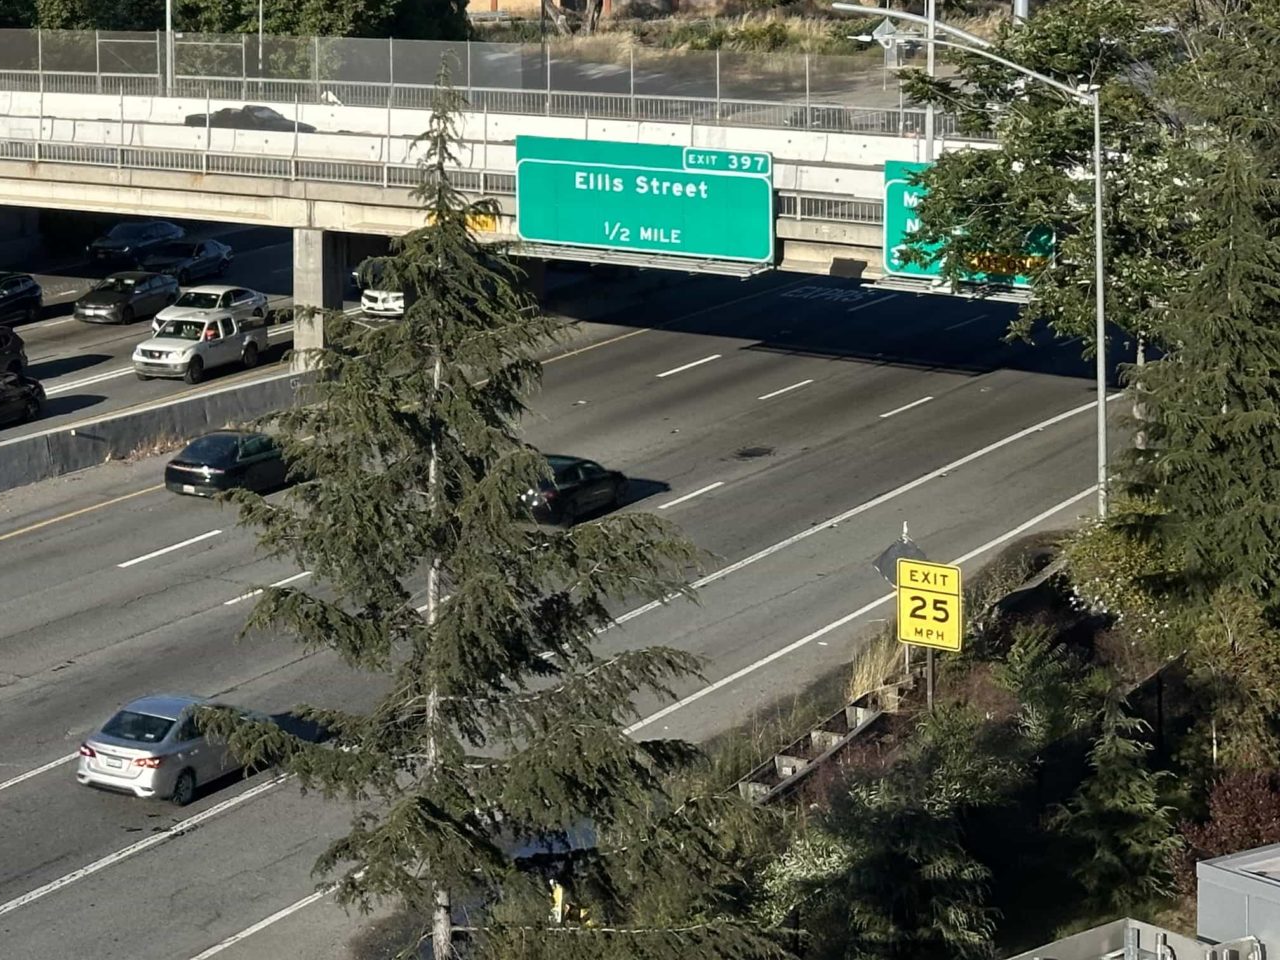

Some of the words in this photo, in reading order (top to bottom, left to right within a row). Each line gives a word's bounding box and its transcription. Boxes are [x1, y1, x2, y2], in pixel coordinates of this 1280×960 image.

[688, 154, 718, 166] EXIT
[727, 155, 765, 171] 397
[575, 172, 624, 192] Ellis
[636, 176, 708, 198] Street
[604, 221, 630, 242] 1/2
[639, 226, 681, 243] MILE
[909, 569, 949, 586] EXIT
[909, 595, 949, 623] 25
[914, 627, 945, 641] MPH
